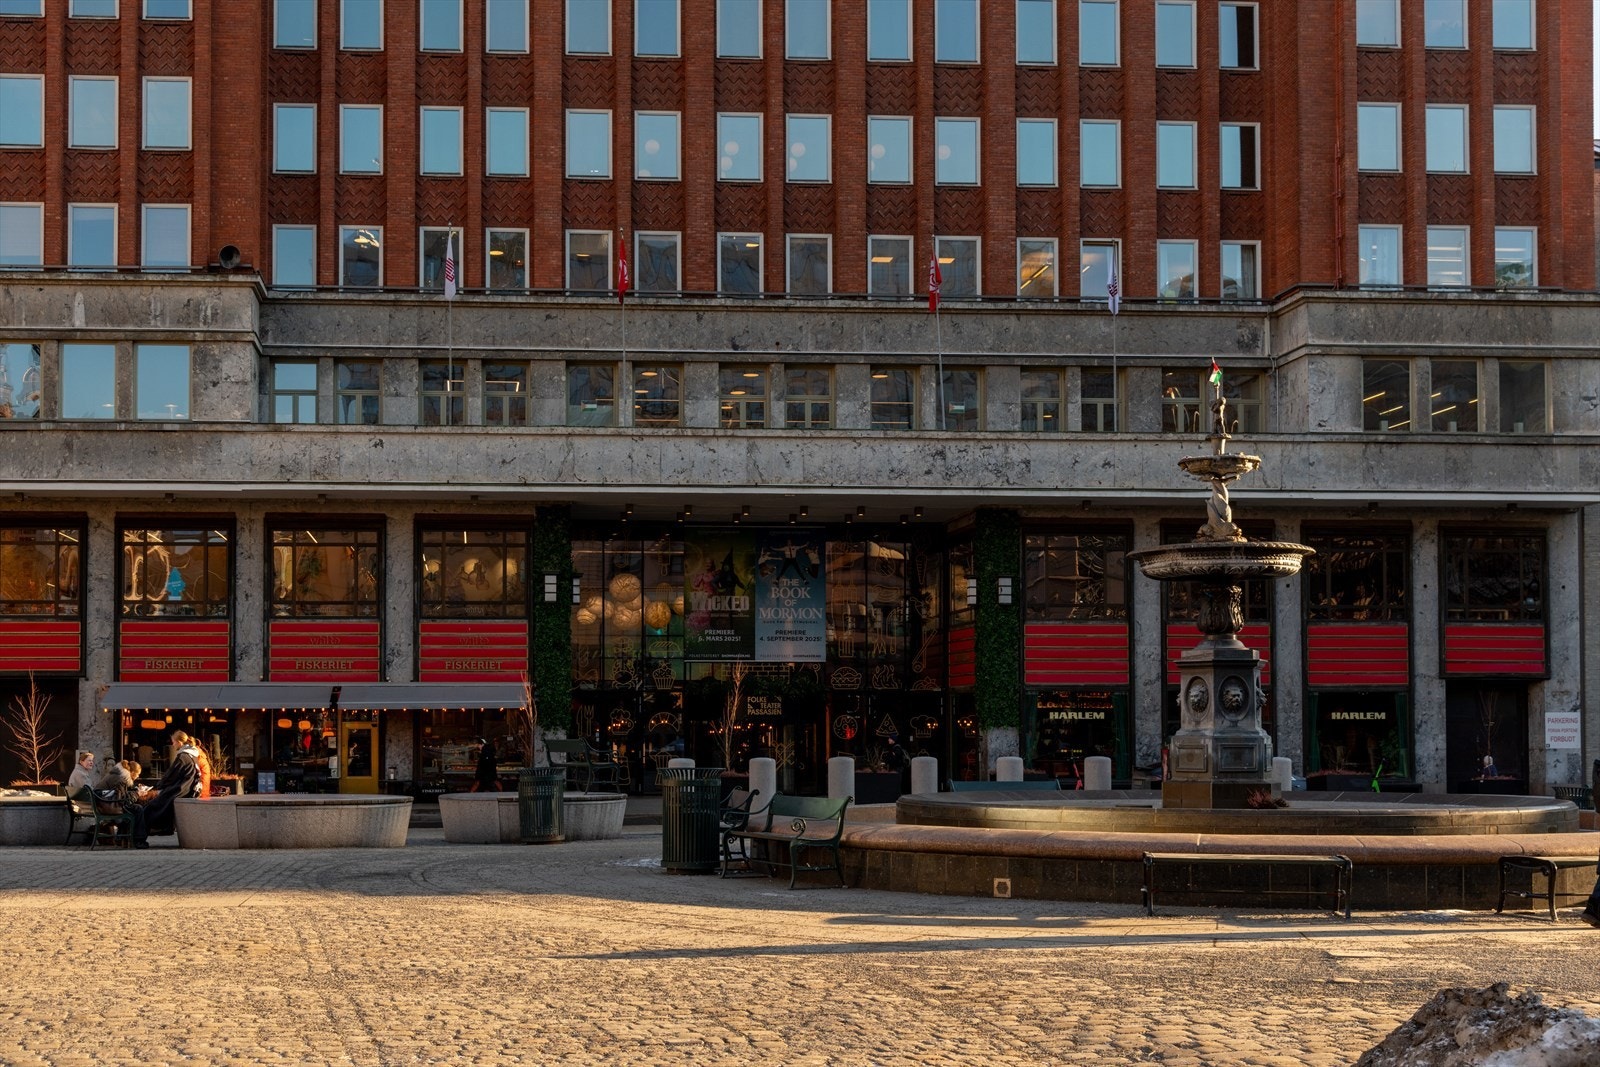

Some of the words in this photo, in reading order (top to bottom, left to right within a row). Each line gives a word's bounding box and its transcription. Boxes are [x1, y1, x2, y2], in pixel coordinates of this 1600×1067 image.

[782, 578, 800, 586] THE
[771, 587, 811, 599] BOOK
[784, 599, 797, 607] OF
[759, 607, 823, 619] MORMON
[144, 659, 204, 670] FISKERIET
[295, 660, 354, 671] FISKERIET
[444, 660, 503, 671] FISKERIET
[1048, 711, 1105, 720] HARLEM
[1331, 711, 1387, 720] HARLEM
